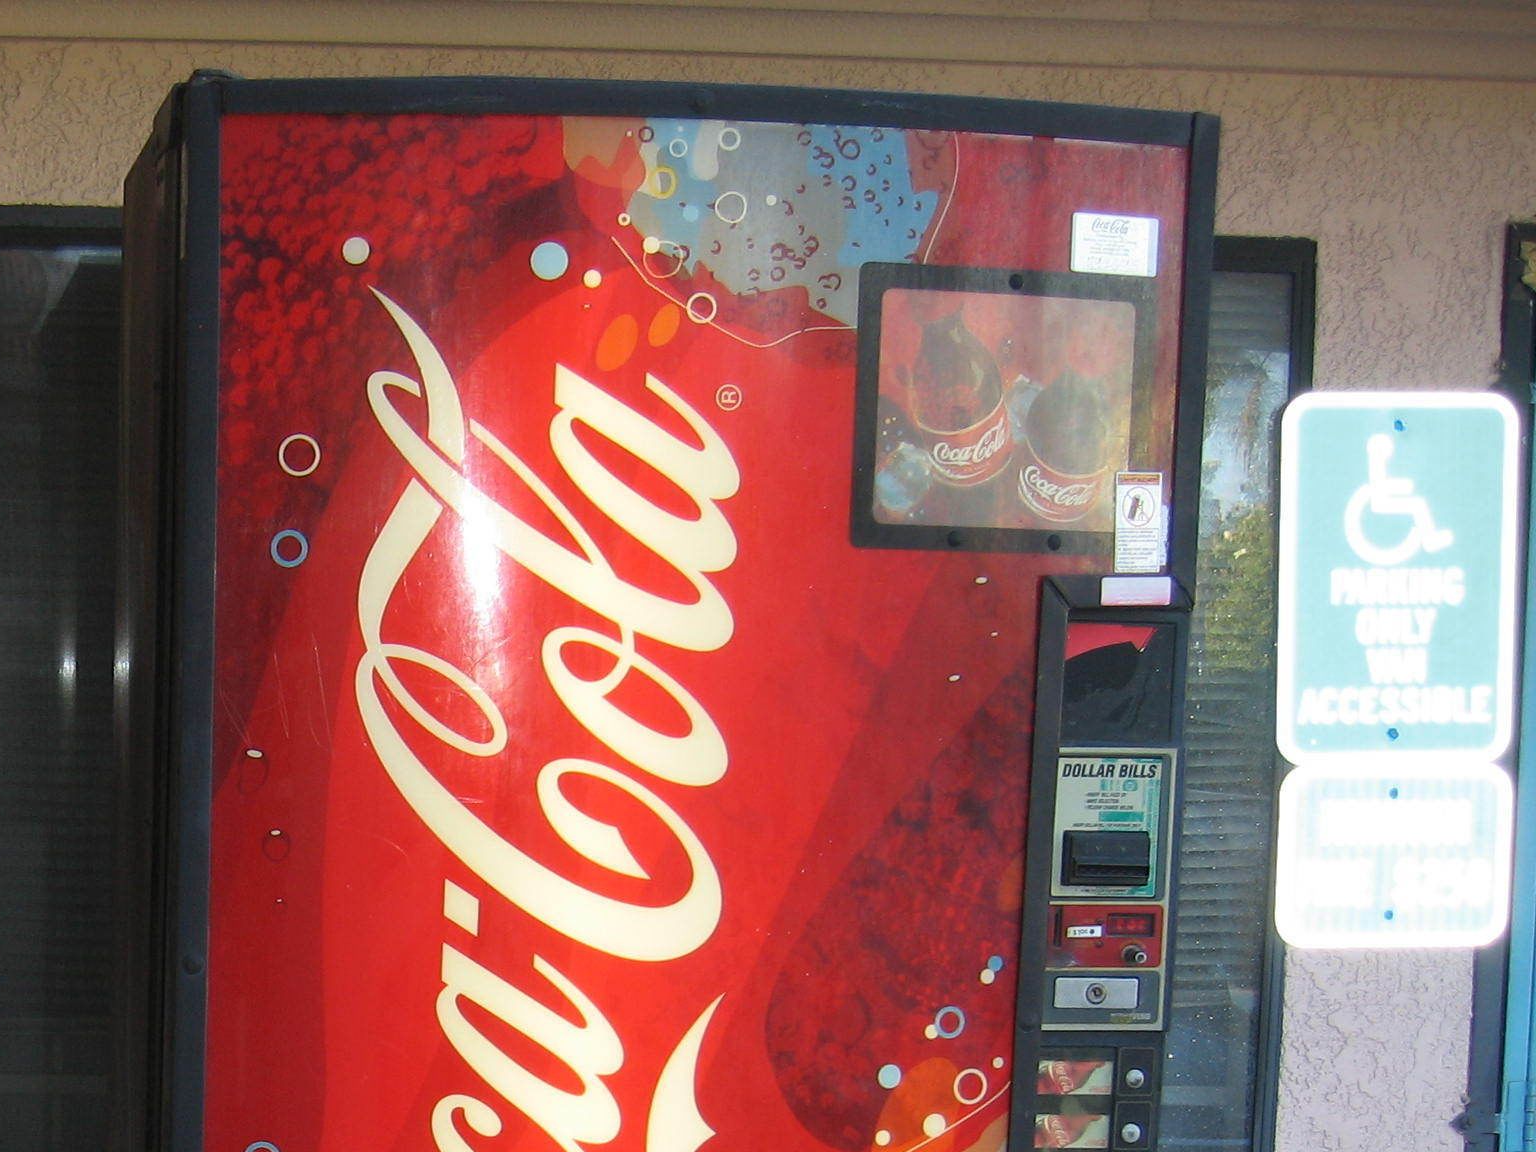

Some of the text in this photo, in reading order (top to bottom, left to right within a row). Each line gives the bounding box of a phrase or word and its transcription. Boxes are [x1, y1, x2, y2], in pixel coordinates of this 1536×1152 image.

[932, 416, 1006, 466] Coca-Cola
[1024, 465, 1097, 507] Coca-Cola
[1329, 566, 1467, 606] PARKING
[1297, 685, 1493, 725] ACCESSIBLE
[1062, 763, 1158, 779] DOLLAR BILLS
